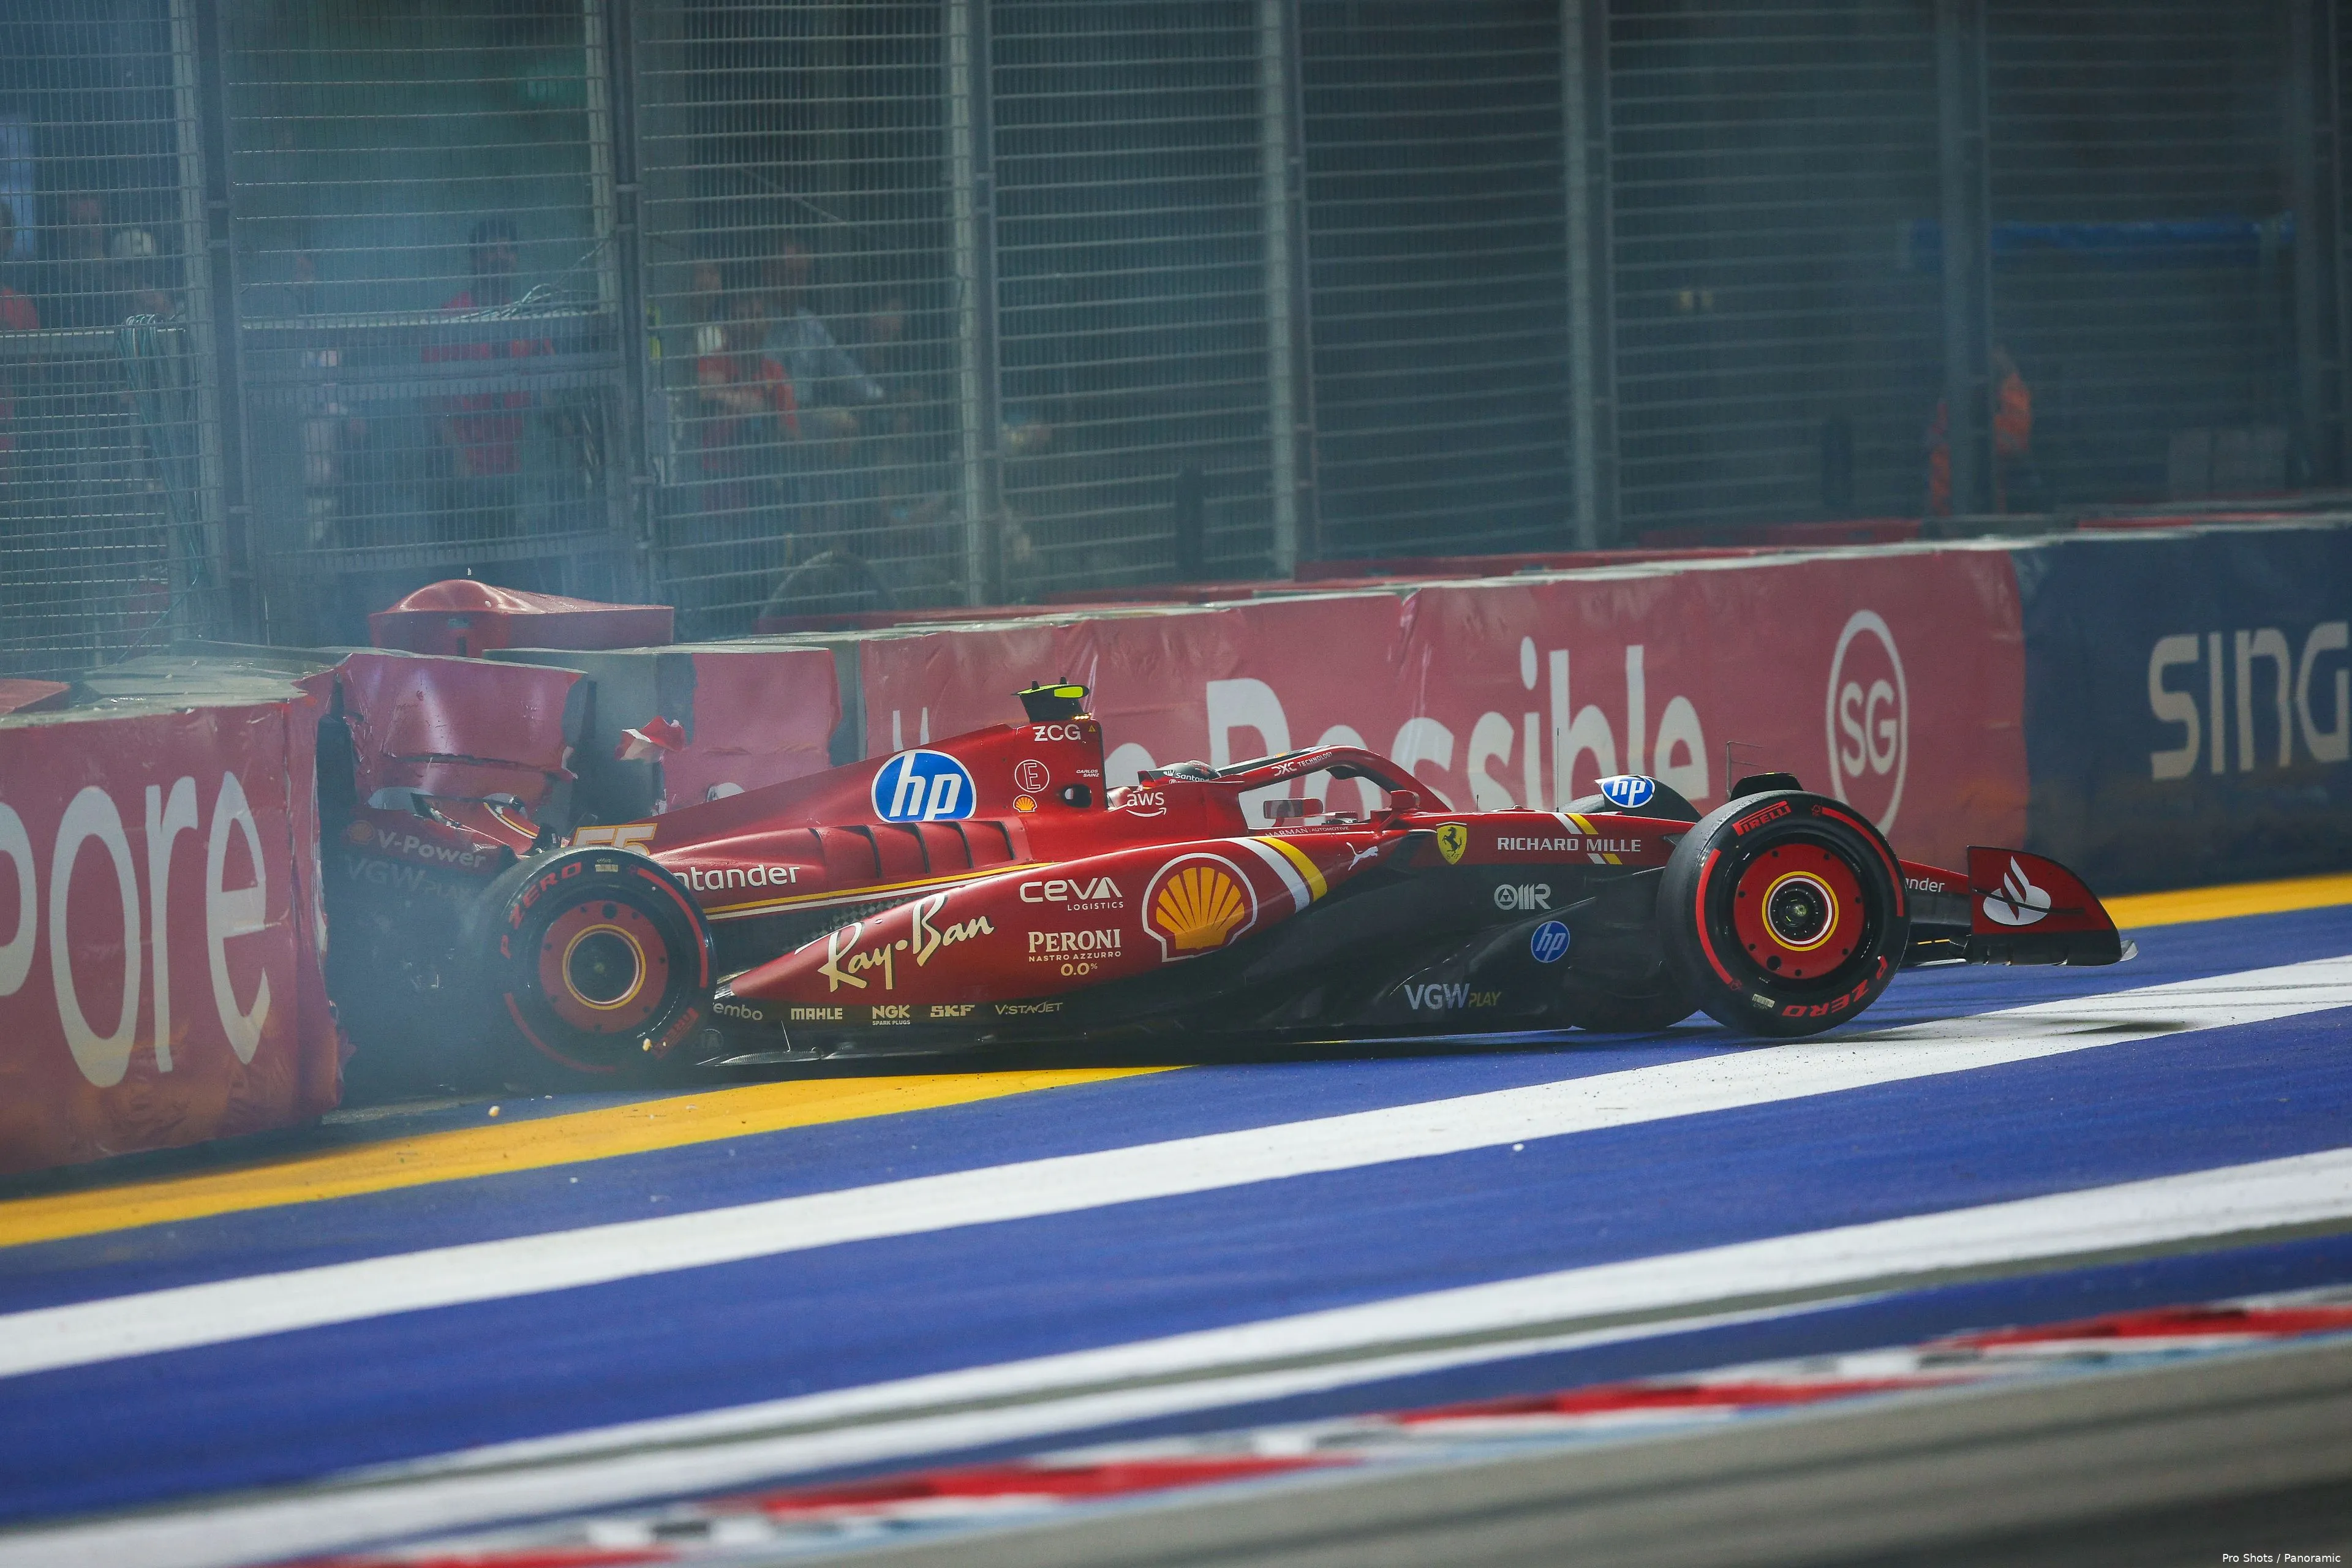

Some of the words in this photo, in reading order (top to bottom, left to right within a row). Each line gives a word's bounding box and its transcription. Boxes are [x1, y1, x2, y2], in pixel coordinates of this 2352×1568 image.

[1032, 723, 1081, 742] ZCG
[1840, 679, 1898, 777] SG
[1270, 761, 1298, 777] DXC
[1297, 751, 1333, 767] TECHNOLOGY
[889, 748, 962, 821] hp
[1023, 762, 1041, 790] E
[1175, 772, 1210, 783] Santan
[1126, 791, 1165, 807] aws
[1611, 775, 1646, 808] hp
[1732, 800, 1792, 837] PIRELLI
[1264, 828, 1309, 837] HARMAN
[377, 829, 487, 868] V-Power
[1497, 837, 1579, 851] RICHARD
[1586, 839, 1642, 853] MILLE
[508, 862, 582, 930] ZERO
[1067, 901, 1124, 911] LOGISTICS
[1028, 929, 1121, 954] PERONI
[1536, 924, 1564, 962] hp
[1028, 954, 1070, 962] NASTRO
[1072, 951, 1121, 960] AZZURRO
[1060, 962, 1098, 977] 0.0%
[1404, 983, 1471, 1010] VGW
[1469, 991, 1502, 1008] PLAY
[1782, 979, 1869, 1017] ZERO
[713, 1002, 764, 1021] embo
[791, 1008, 843, 1020] MAHLE
[872, 1004, 910, 1019] NGK
[930, 1004, 975, 1018] SKF
